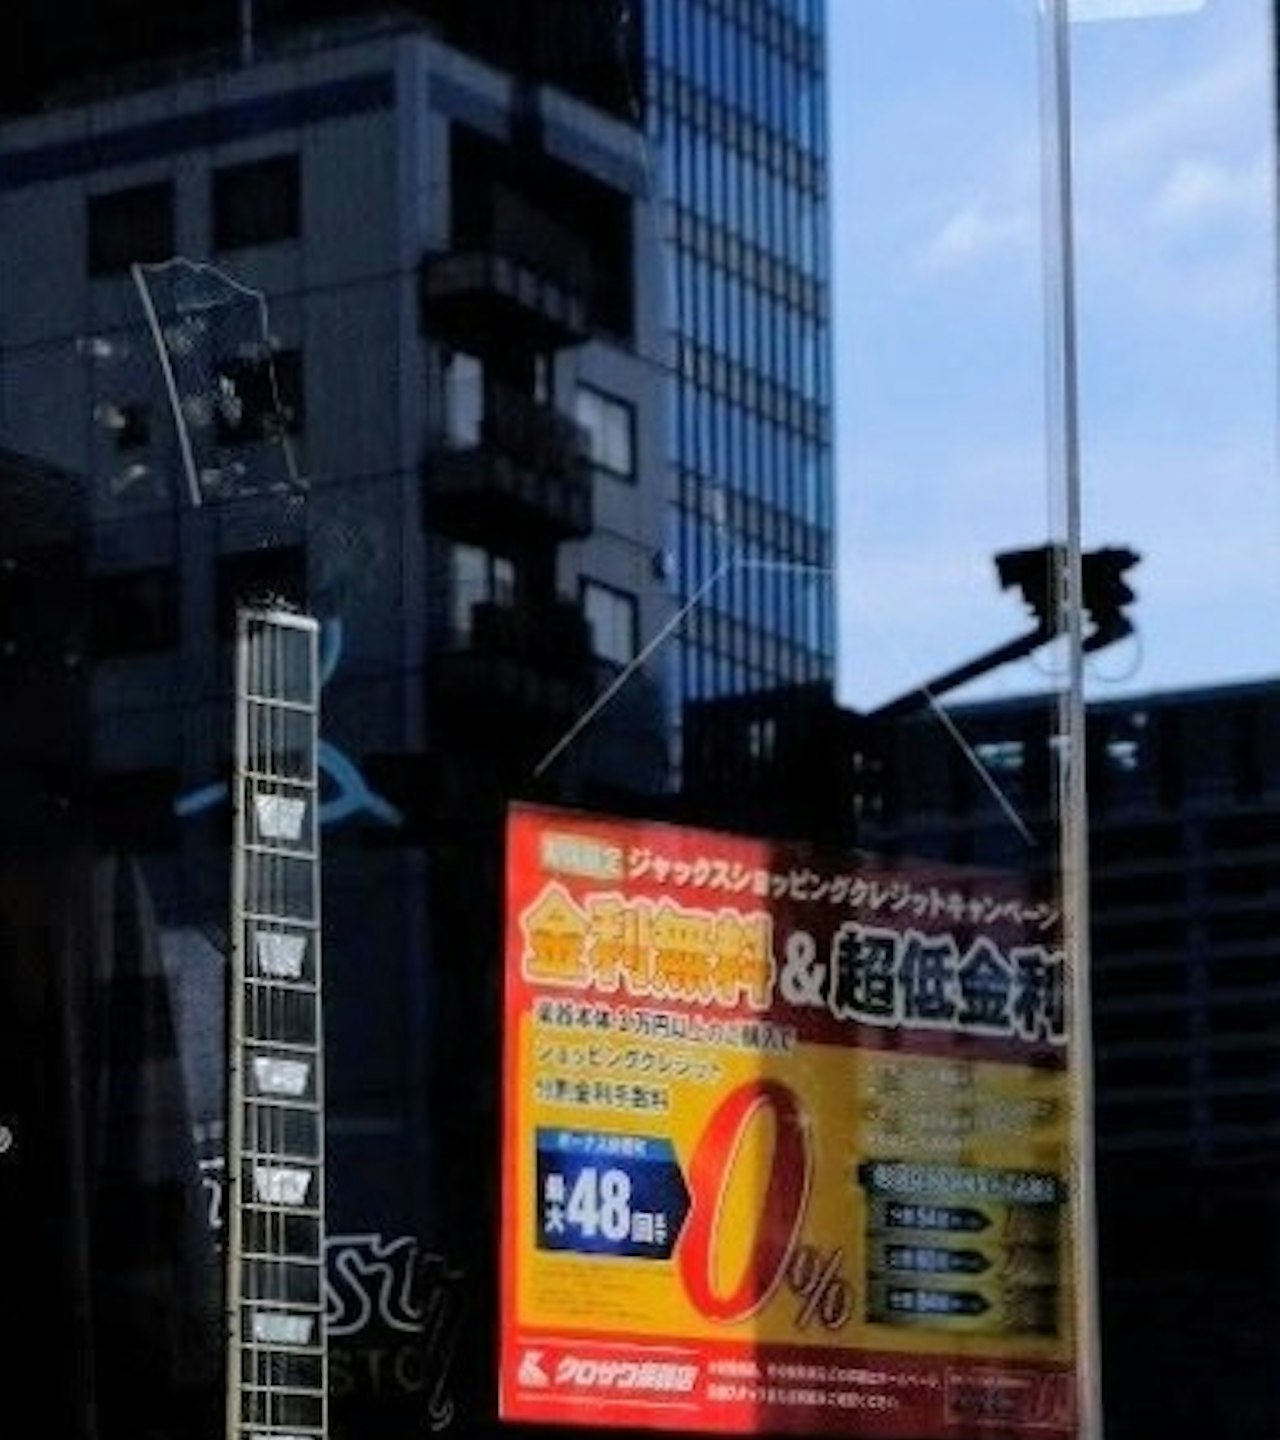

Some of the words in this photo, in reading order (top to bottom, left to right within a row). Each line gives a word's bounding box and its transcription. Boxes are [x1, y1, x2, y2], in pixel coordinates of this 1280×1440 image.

[523, 880, 774, 1009] 金利無料
[781, 931, 827, 1007] &
